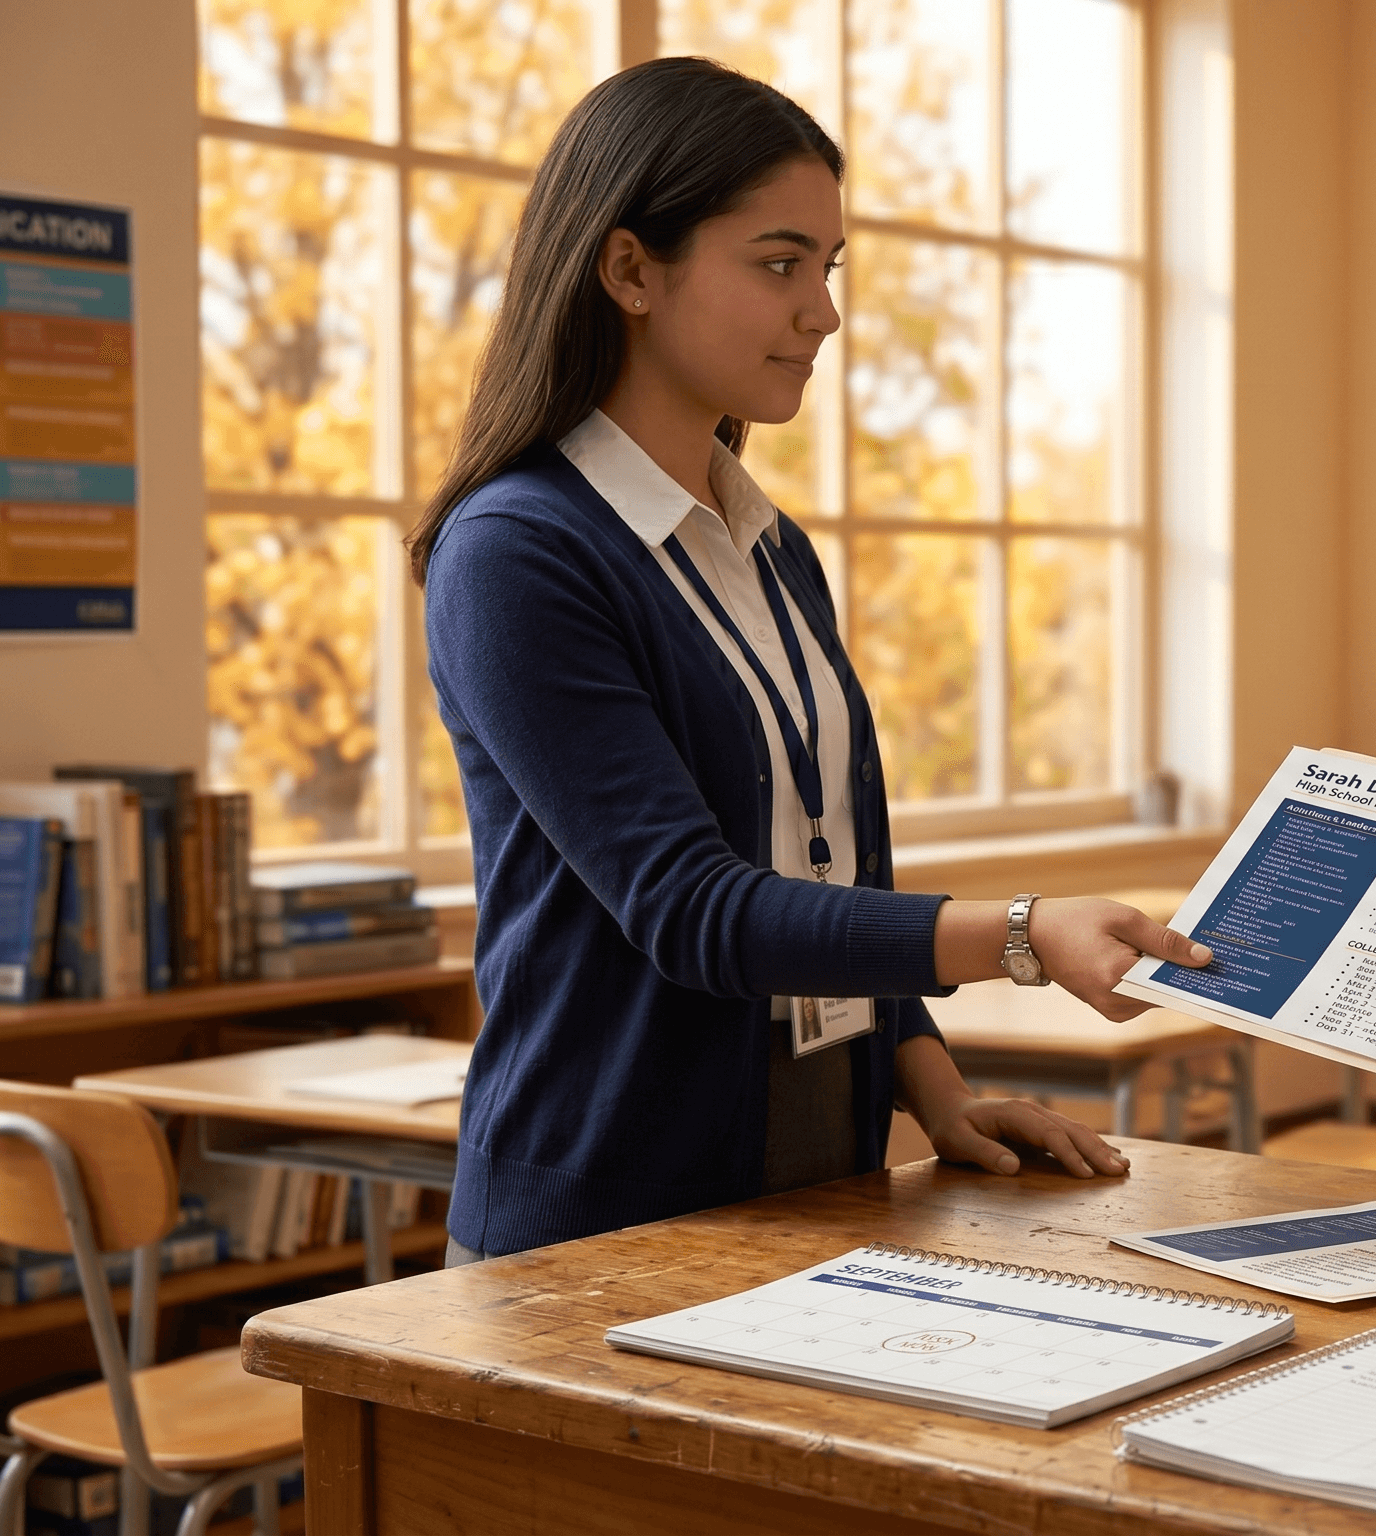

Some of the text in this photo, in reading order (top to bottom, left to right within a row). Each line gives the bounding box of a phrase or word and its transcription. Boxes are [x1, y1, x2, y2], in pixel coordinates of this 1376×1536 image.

[1303, 763, 1361, 789] Sarah
[1295, 779, 1327, 795] High
[1329, 787, 1374, 806] School
[836, 1264, 963, 1290] SEPTEMBER
